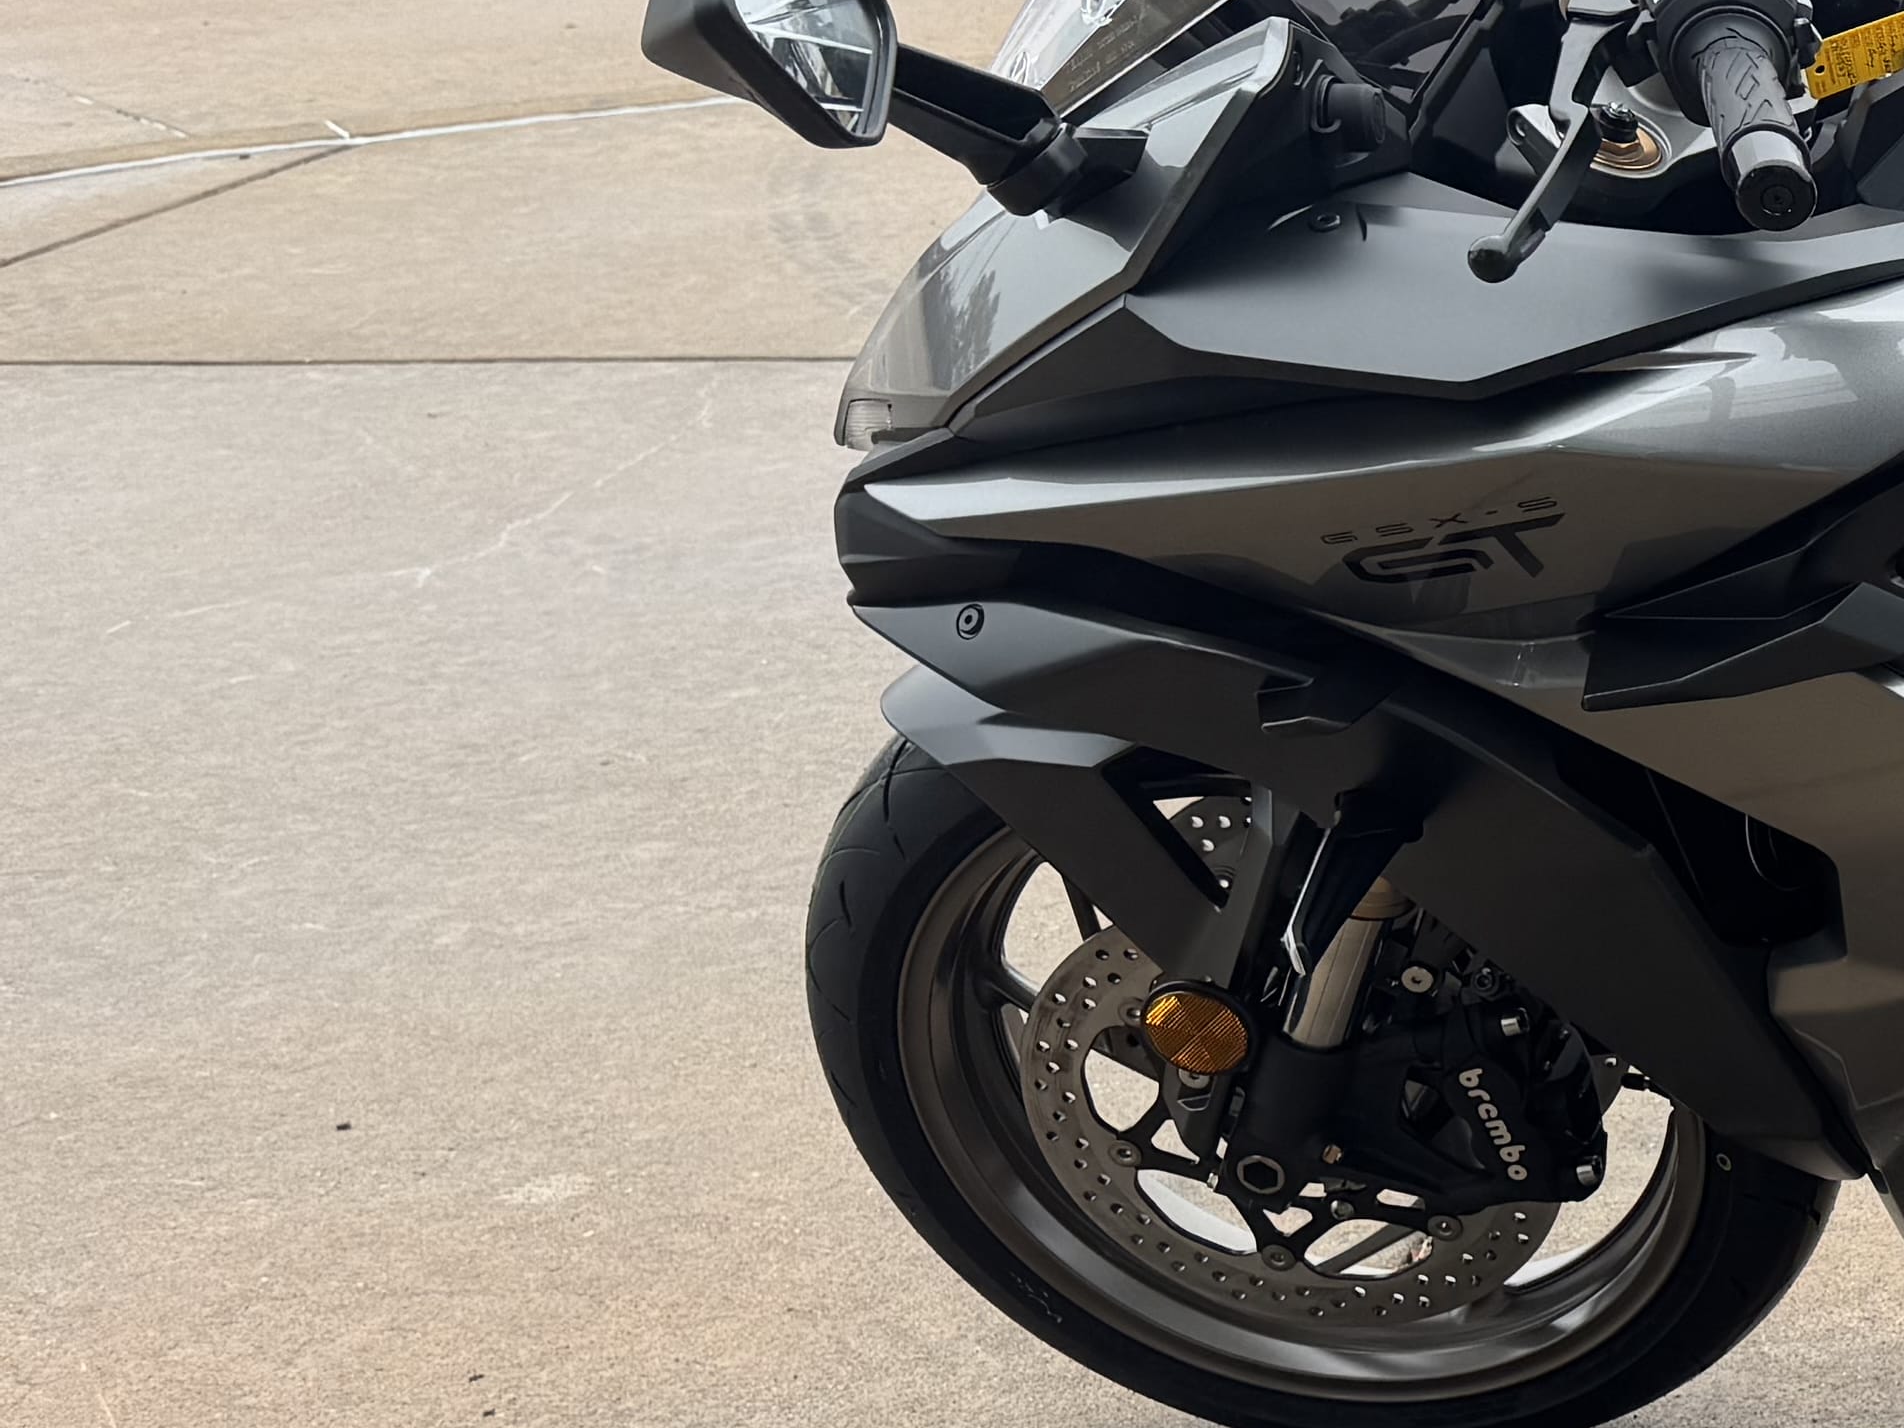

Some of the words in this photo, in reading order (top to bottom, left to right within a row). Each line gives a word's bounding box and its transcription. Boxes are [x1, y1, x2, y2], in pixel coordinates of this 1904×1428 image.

[1319, 496, 1558, 545] GSX-S
[1342, 513, 1566, 584] GT
[1458, 1068, 1528, 1181] brembo
